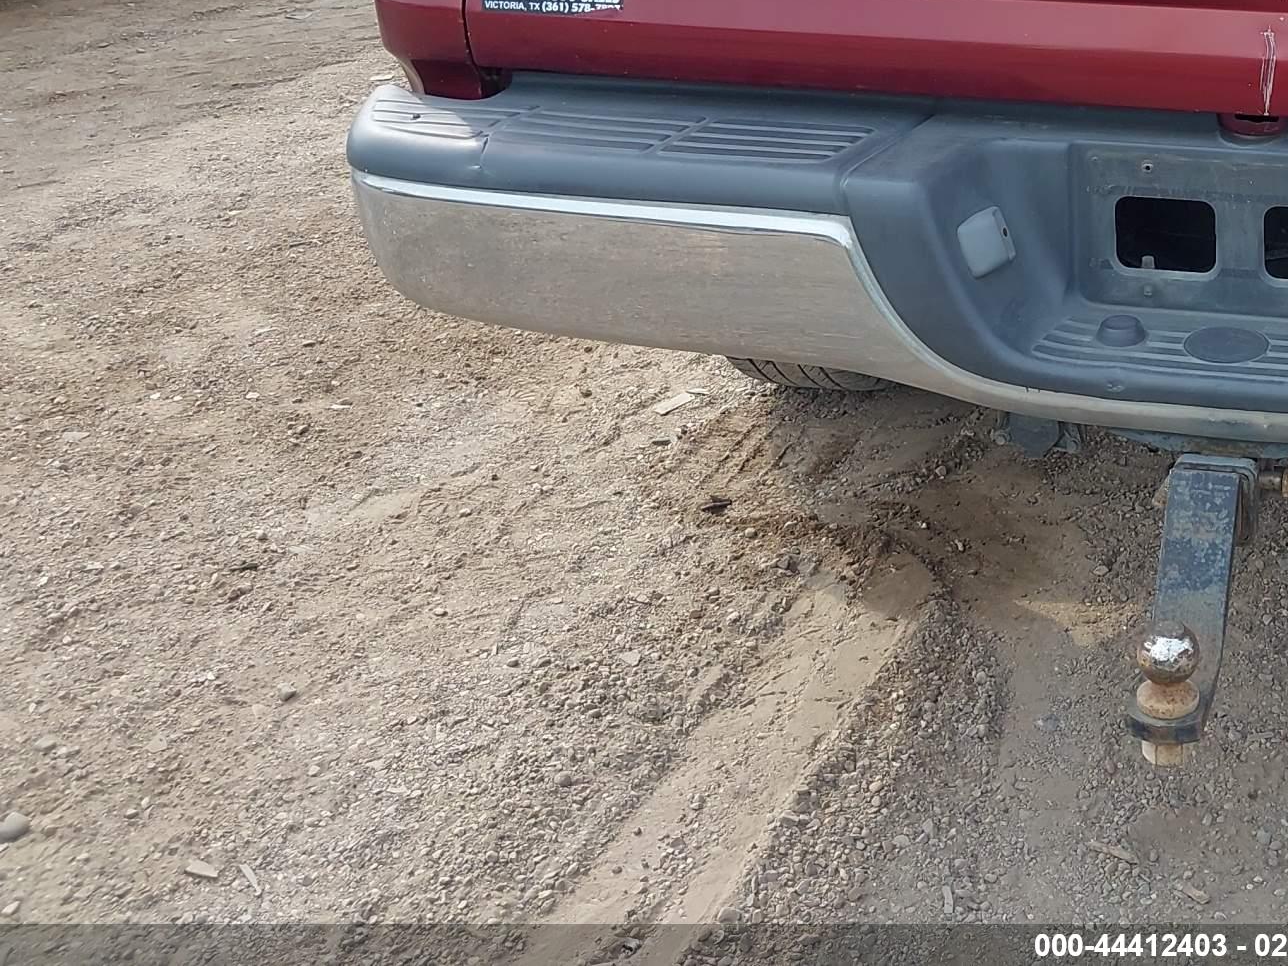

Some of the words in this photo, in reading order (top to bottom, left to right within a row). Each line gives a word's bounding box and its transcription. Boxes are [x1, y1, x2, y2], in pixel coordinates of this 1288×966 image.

[484, 0, 527, 11] VICTORIA,
[528, 2, 540, 11] TX
[541, 1, 570, 13] (361)
